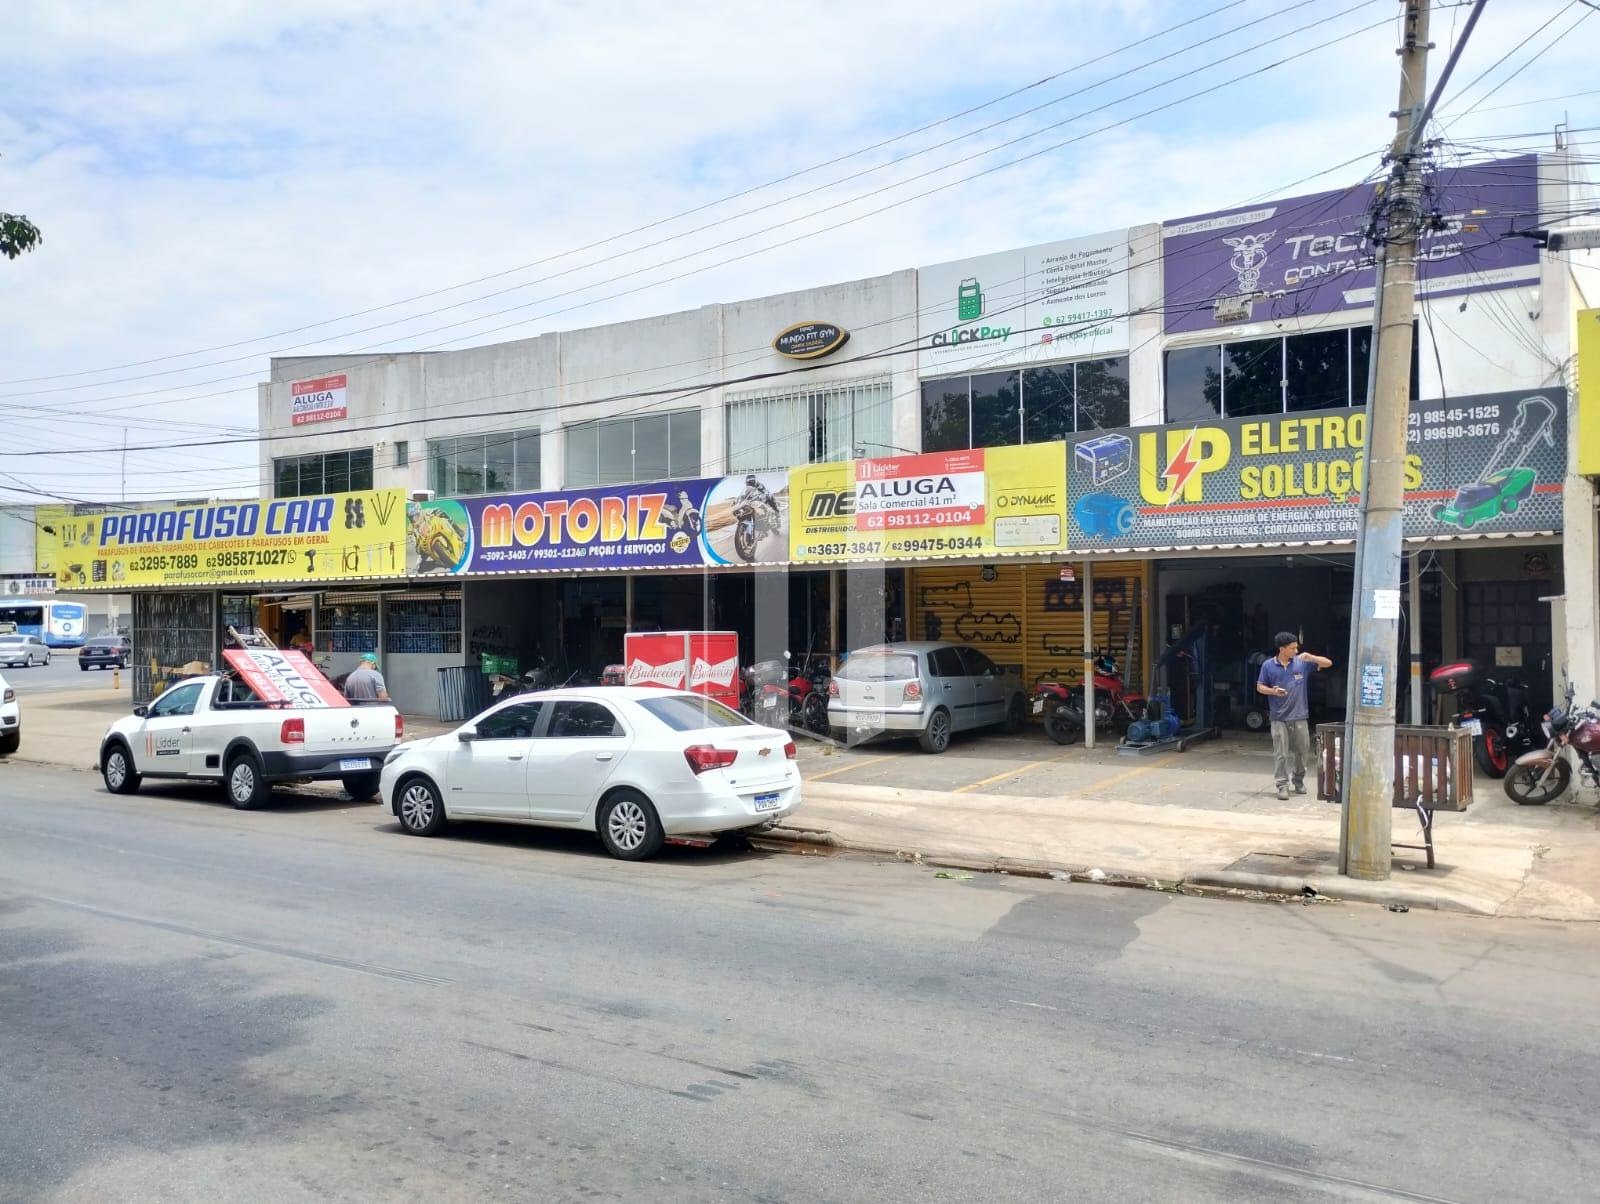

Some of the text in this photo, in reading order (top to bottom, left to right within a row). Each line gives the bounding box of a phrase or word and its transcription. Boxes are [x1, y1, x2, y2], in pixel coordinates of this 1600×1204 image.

[1065, 262, 1085, 270] Digital
[1086, 258, 1108, 266] Master
[780, 334, 805, 345] MUNDO
[806, 331, 818, 340] FIT
[819, 328, 835, 338] GYN
[293, 391, 334, 405] ALUGA
[1241, 413, 1367, 456] ELETRO
[1423, 405, 1500, 424] 98545-1525
[1423, 422, 1500, 441] 99690-3676
[1138, 427, 1231, 506] UP
[859, 476, 956, 499] ALUGA
[858, 500, 878, 511] Sala
[880, 496, 926, 509] Comercial
[928, 496, 939, 506] 41
[1010, 493, 1056, 506] DYNAMIC
[99, 497, 335, 547] PARAFUSO CAR
[481, 492, 667, 548] MOTOBIZ
[867, 510, 972, 528] 62 98112-0104
[1200, 516, 1214, 525] EM
[1215, 513, 1255, 524] GERADOR
[1257, 512, 1269, 522] DE
[1315, 508, 1360, 519] MOTORES
[1176, 528, 1212, 538] BOMBAS
[1264, 522, 1322, 535] CORTADORES
[1324, 521, 1337, 532] DE
[130, 546, 138, 554] DE
[161, 543, 197, 553] PARAFUSOS
[198, 542, 207, 550] DE
[246, 539, 251, 548] E
[252, 537, 292, 547] PARAFUSOS
[293, 536, 304, 545] EM
[306, 535, 329, 544] GERAL
[588, 544, 615, 557] PEÇAS
[616, 545, 622, 554] E
[623, 542, 666, 556] SERVIÇOS
[807, 546, 817, 554] 62
[817, 541, 881, 556] 3637-3847
[892, 542, 902, 551] 62
[903, 536, 983, 552] 99475-0344
[130, 549, 288, 571] 62 3295-7889 62 985871027
[628, 664, 733, 680] Budweiser Budweiser
